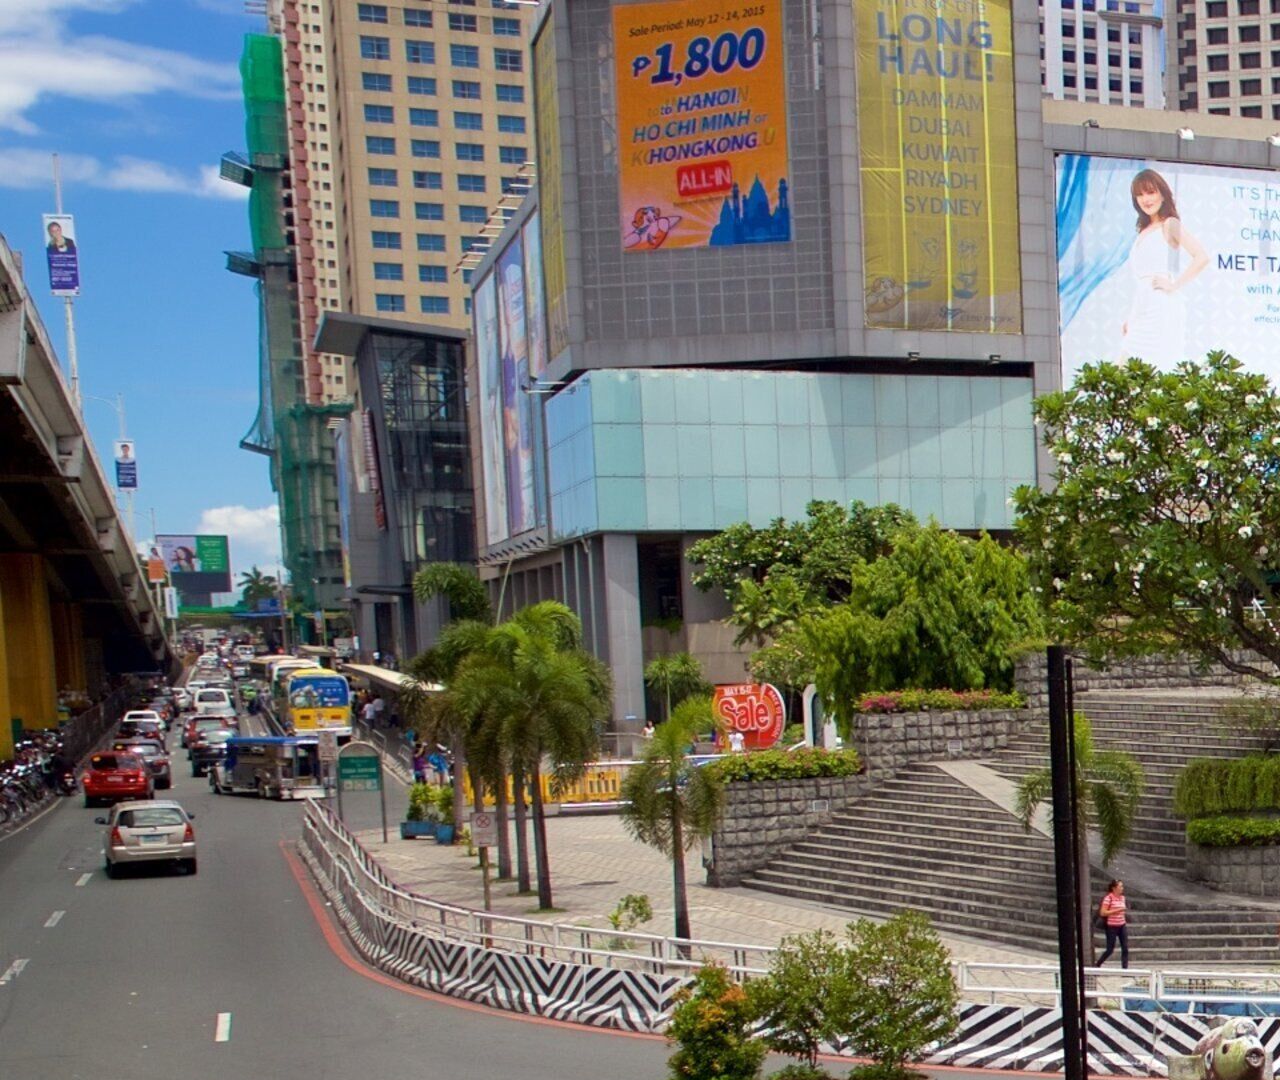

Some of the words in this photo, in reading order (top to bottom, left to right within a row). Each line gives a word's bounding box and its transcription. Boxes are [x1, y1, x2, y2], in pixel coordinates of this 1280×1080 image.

[629, 26, 650, 38] Sale
[650, 20, 683, 33] Period:
[686, 16, 706, 28] May
[707, 14, 719, 23] 12
[742, 6, 765, 18] 2015
[877, 11, 992, 49] LONG
[878, 45, 993, 82] HAUL!
[892, 88, 984, 112] DAMMAM
[633, 124, 660, 143] HO
[665, 118, 697, 138] CHI
[701, 109, 751, 131] MINH
[909, 116, 972, 138] DUBAI
[649, 132, 757, 165] HONGKONG
[902, 143, 979, 163] KUWAIT
[680, 167, 731, 191] ALL-IN
[906, 169, 977, 191] RIYADH
[1232, 186, 1260, 201] IT'S
[904, 195, 982, 217] SYDNEY
[1217, 254, 1259, 271] MET
[1247, 285, 1273, 295] with
[718, 696, 769, 732] Sale
